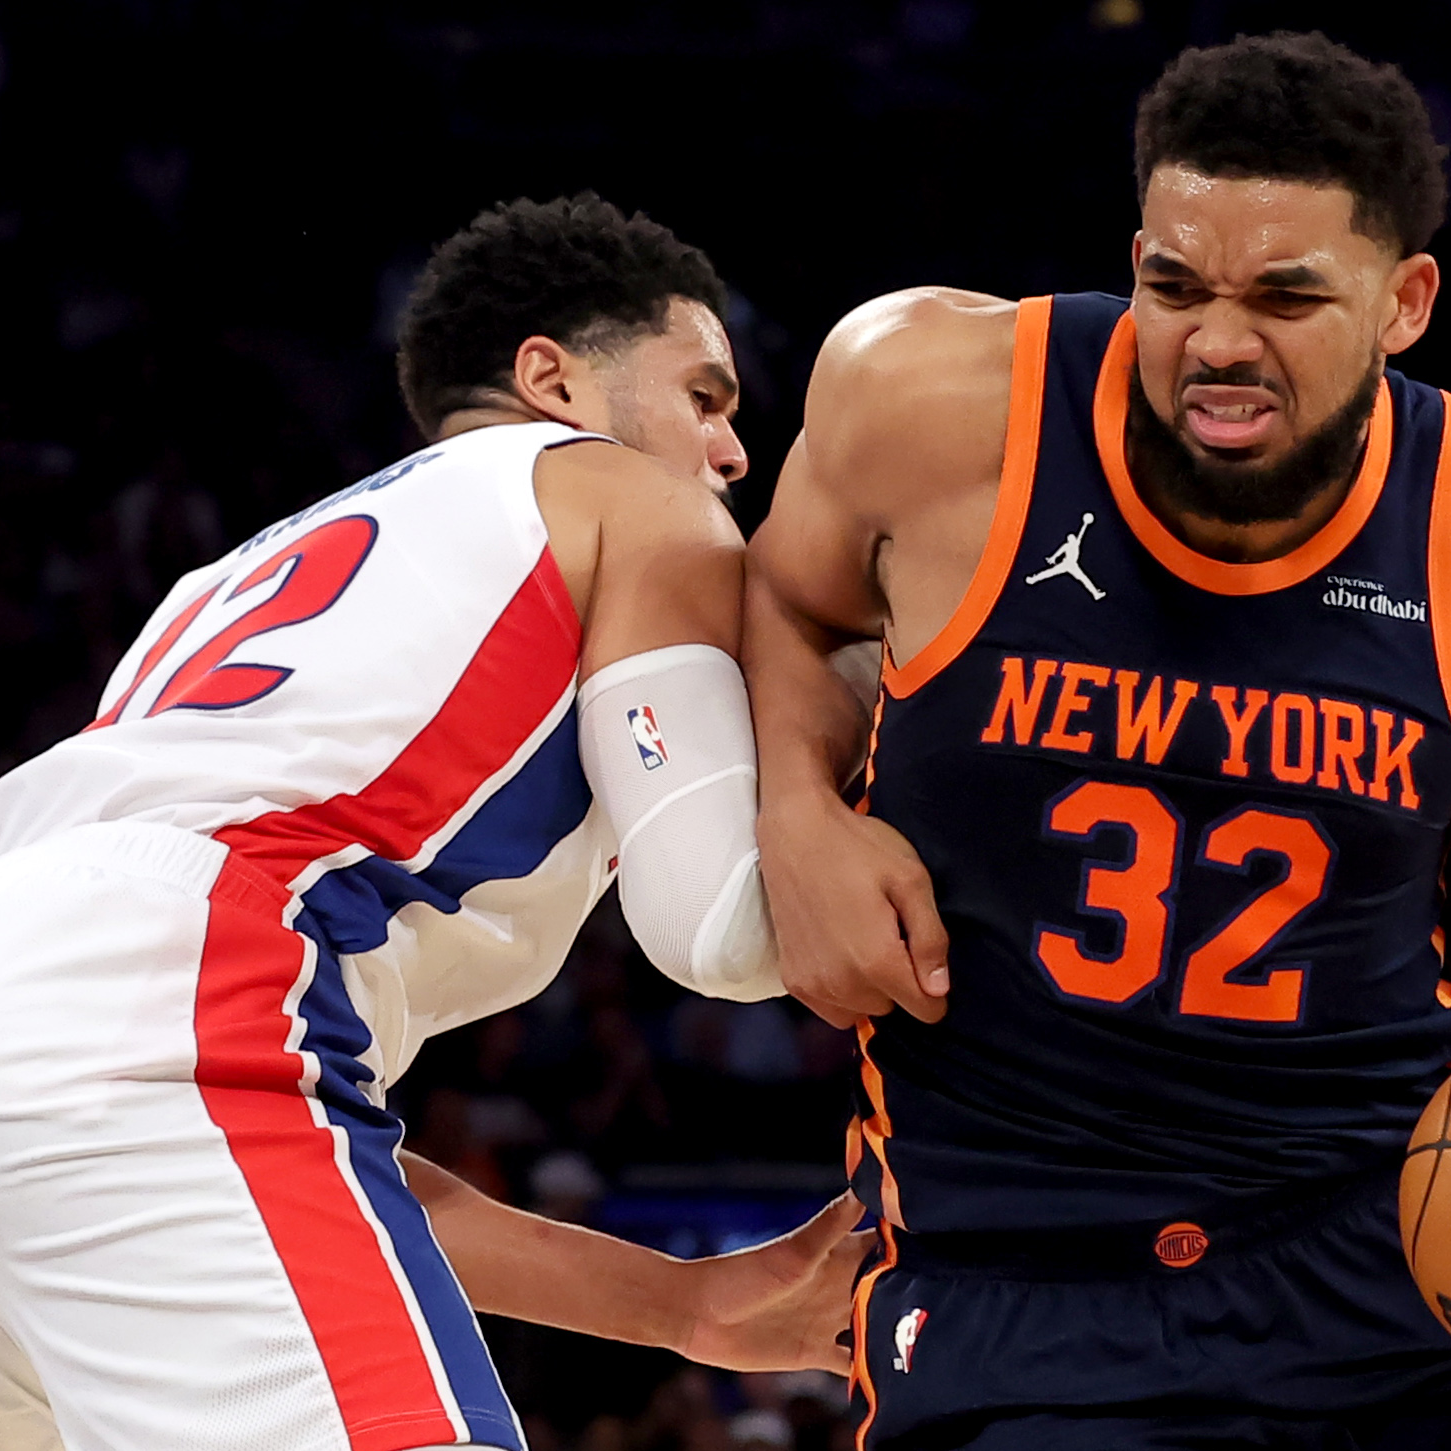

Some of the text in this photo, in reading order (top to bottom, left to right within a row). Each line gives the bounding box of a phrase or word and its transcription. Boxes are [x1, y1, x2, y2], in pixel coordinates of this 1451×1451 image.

[79, 513, 379, 734] 12
[1322, 587, 1427, 622] abu dhabi
[1326, 575, 1385, 592] experience
[980, 656, 1425, 811] NEW YORK
[1033, 779, 1337, 1025] 32
